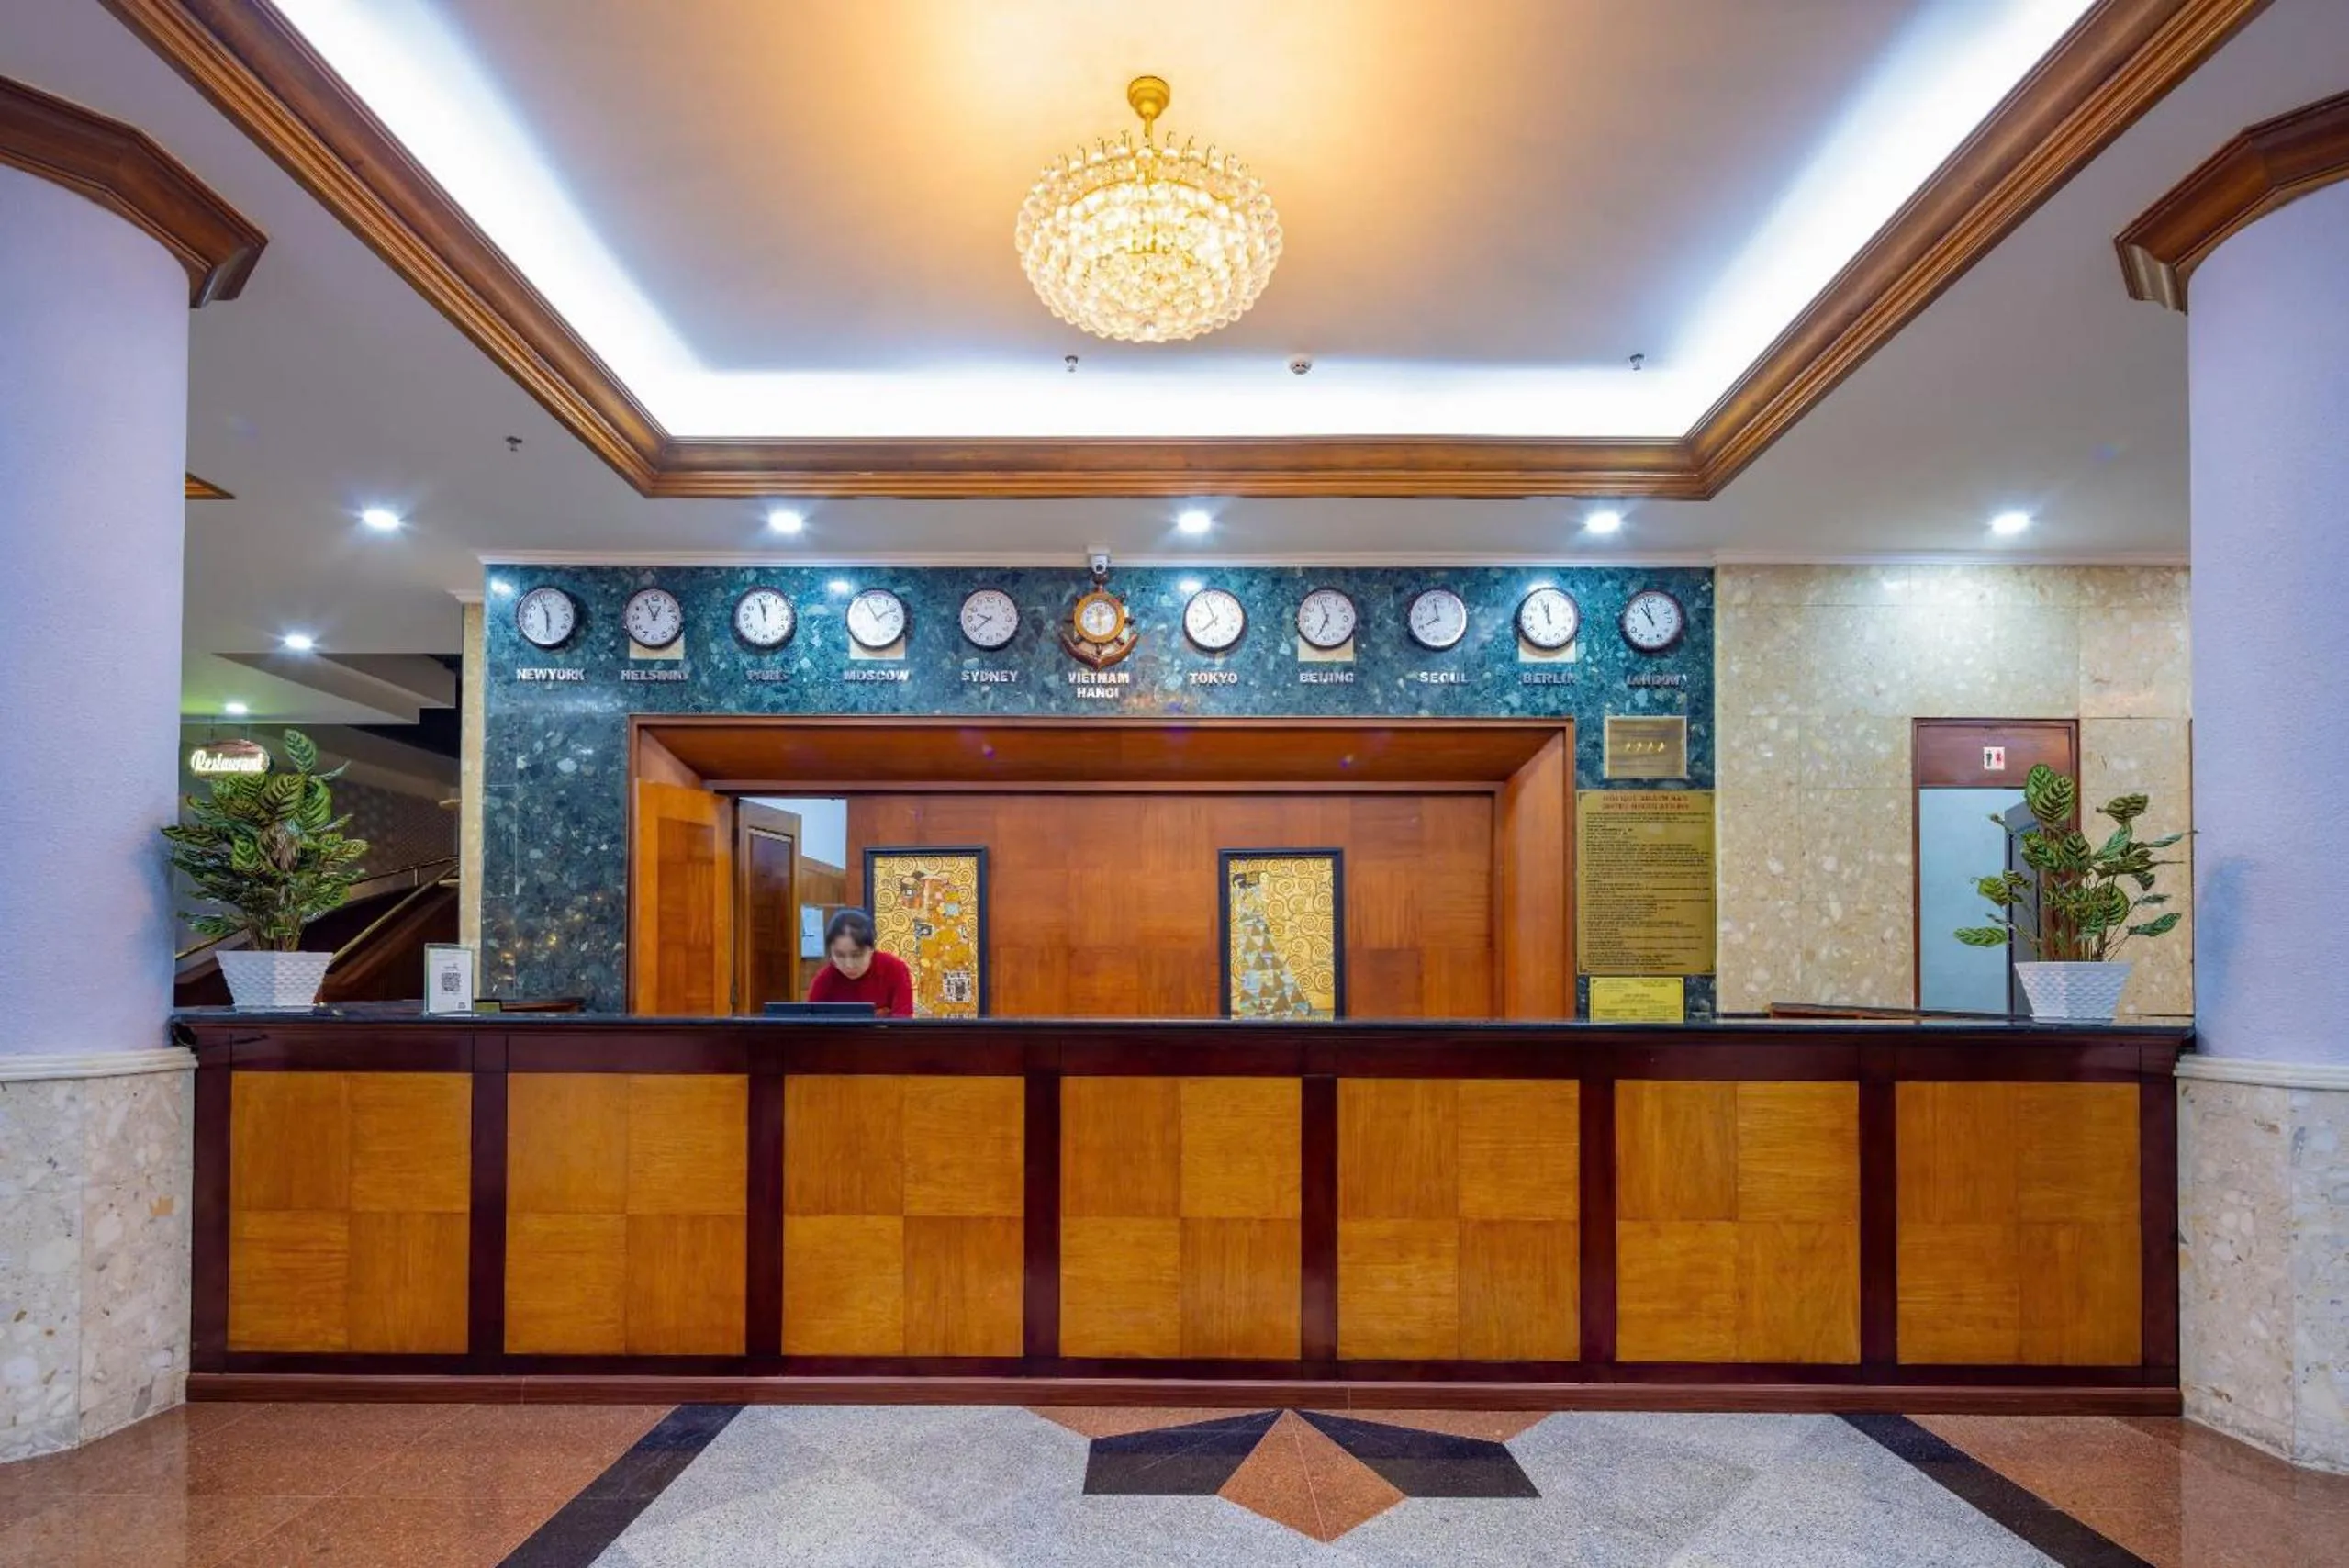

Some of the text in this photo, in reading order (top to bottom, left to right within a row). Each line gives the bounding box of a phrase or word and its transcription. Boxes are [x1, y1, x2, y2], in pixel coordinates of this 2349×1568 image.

[516, 668, 585, 681] NEWYORK
[621, 669, 688, 681] HELSINKI
[844, 669, 910, 681] MOSCOW
[961, 670, 1018, 682] SYDNEY
[1068, 672, 1130, 684] VIETNAM
[1189, 672, 1238, 684] TOKYO
[1299, 672, 1354, 683] BEIJING
[1419, 671, 1470, 684] SEOUL
[1523, 672, 1576, 684] BERLIN
[1076, 687, 1119, 699] HANOI
[190, 749, 264, 773] Restaurant
